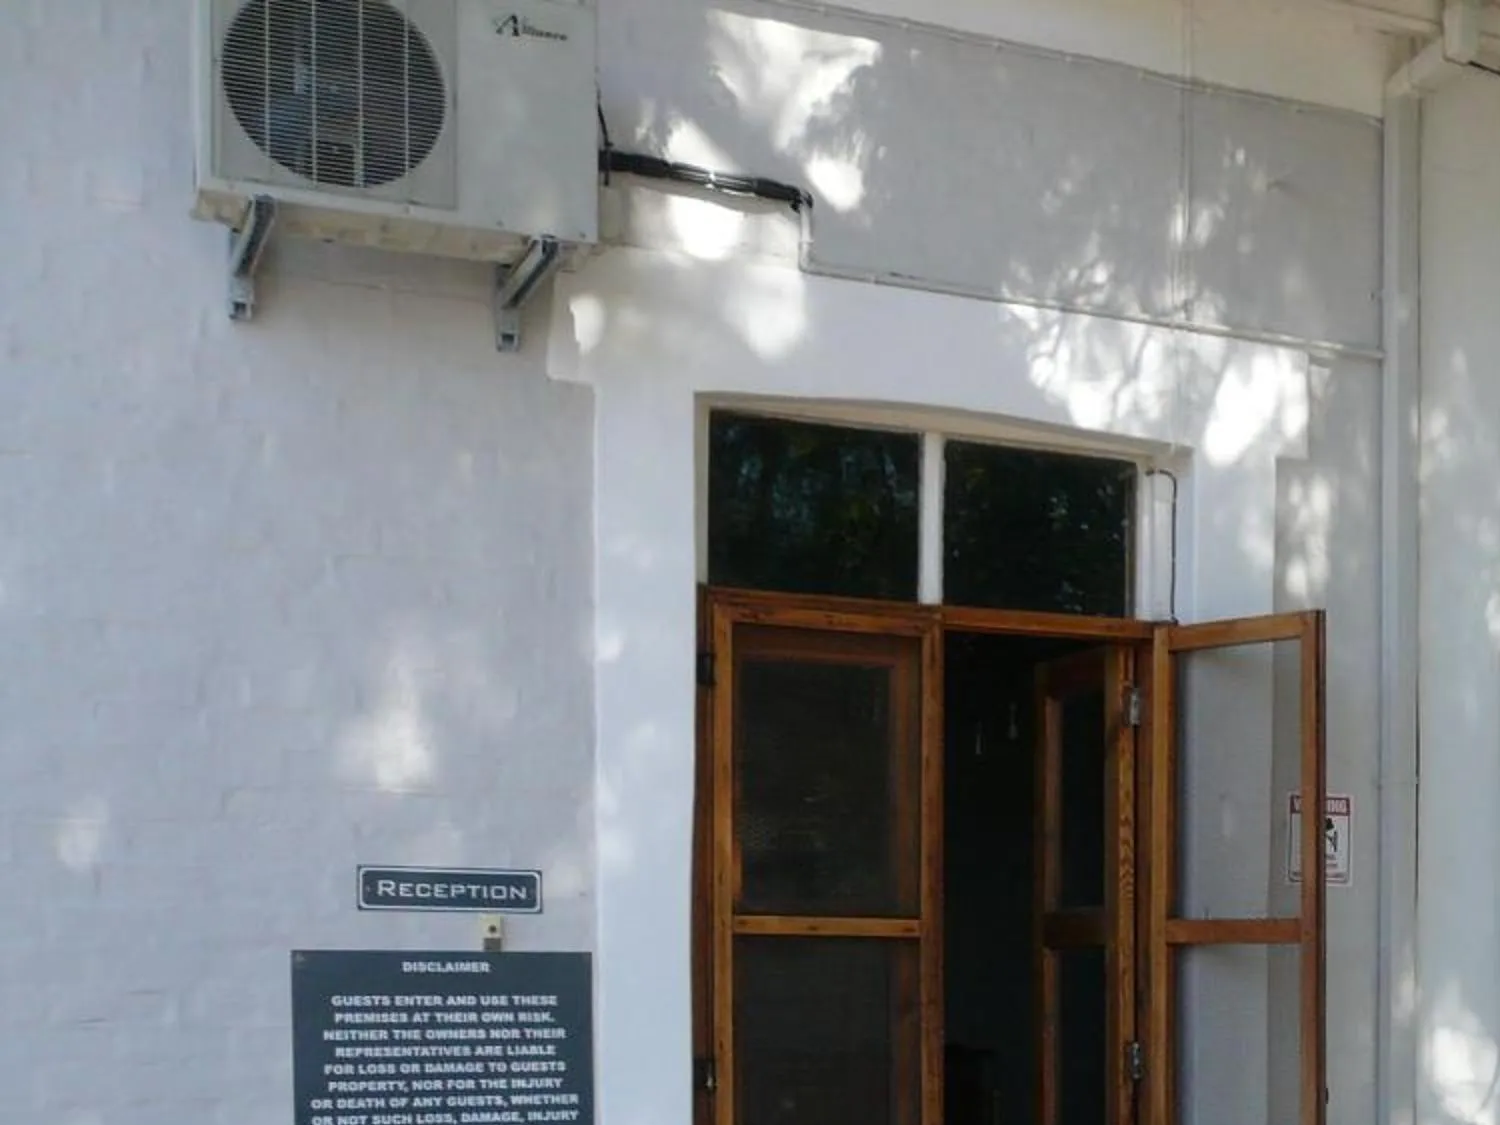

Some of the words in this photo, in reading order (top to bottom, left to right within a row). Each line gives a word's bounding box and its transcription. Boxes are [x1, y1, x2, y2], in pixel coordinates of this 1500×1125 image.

[376, 879, 528, 900] RECEPTION
[402, 961, 490, 973] DISCLAIMER
[331, 995, 391, 1007] GUESTS
[394, 995, 443, 1007] ENTER
[446, 995, 477, 1006] AND
[480, 995, 508, 1006] USE
[511, 995, 557, 1006] THESE
[335, 1012, 408, 1024] PREMISES
[412, 1012, 430, 1023] AT
[435, 1012, 478, 1023] THEIR
[481, 1012, 514, 1022] OWN
[323, 1029, 389, 1041] NEITHER
[392, 1029, 422, 1040] THE
[425, 1029, 486, 1040] OWNERS
[489, 1028, 521, 1039] NOR
[523, 1027, 567, 1039] THEIR
[335, 1045, 472, 1058] REPRESENTATIVES
[474, 1045, 503, 1056] ARE
[506, 1044, 556, 1055] LIABLE
[324, 1063, 355, 1075] FOR
[358, 1063, 396, 1075] LOSS
[400, 1063, 420, 1074] OR
[424, 1061, 484, 1073] DAMAGE
[487, 1061, 507, 1072] TO
[510, 1061, 566, 1072] GUESTS
[412, 1080, 443, 1091] NOR
[446, 1079, 476, 1090] FOR
[479, 1078, 508, 1089] THE
[511, 1078, 563, 1089] INJURY
[310, 1099, 333, 1110] OR
[336, 1098, 385, 1109] DEATH
[388, 1097, 409, 1108] OF
[412, 1096, 442, 1107] ANY
[510, 1093, 579, 1105] WHETHER
[372, 1113, 412, 1125] SUCH
[527, 1110, 579, 1121] INJURY
